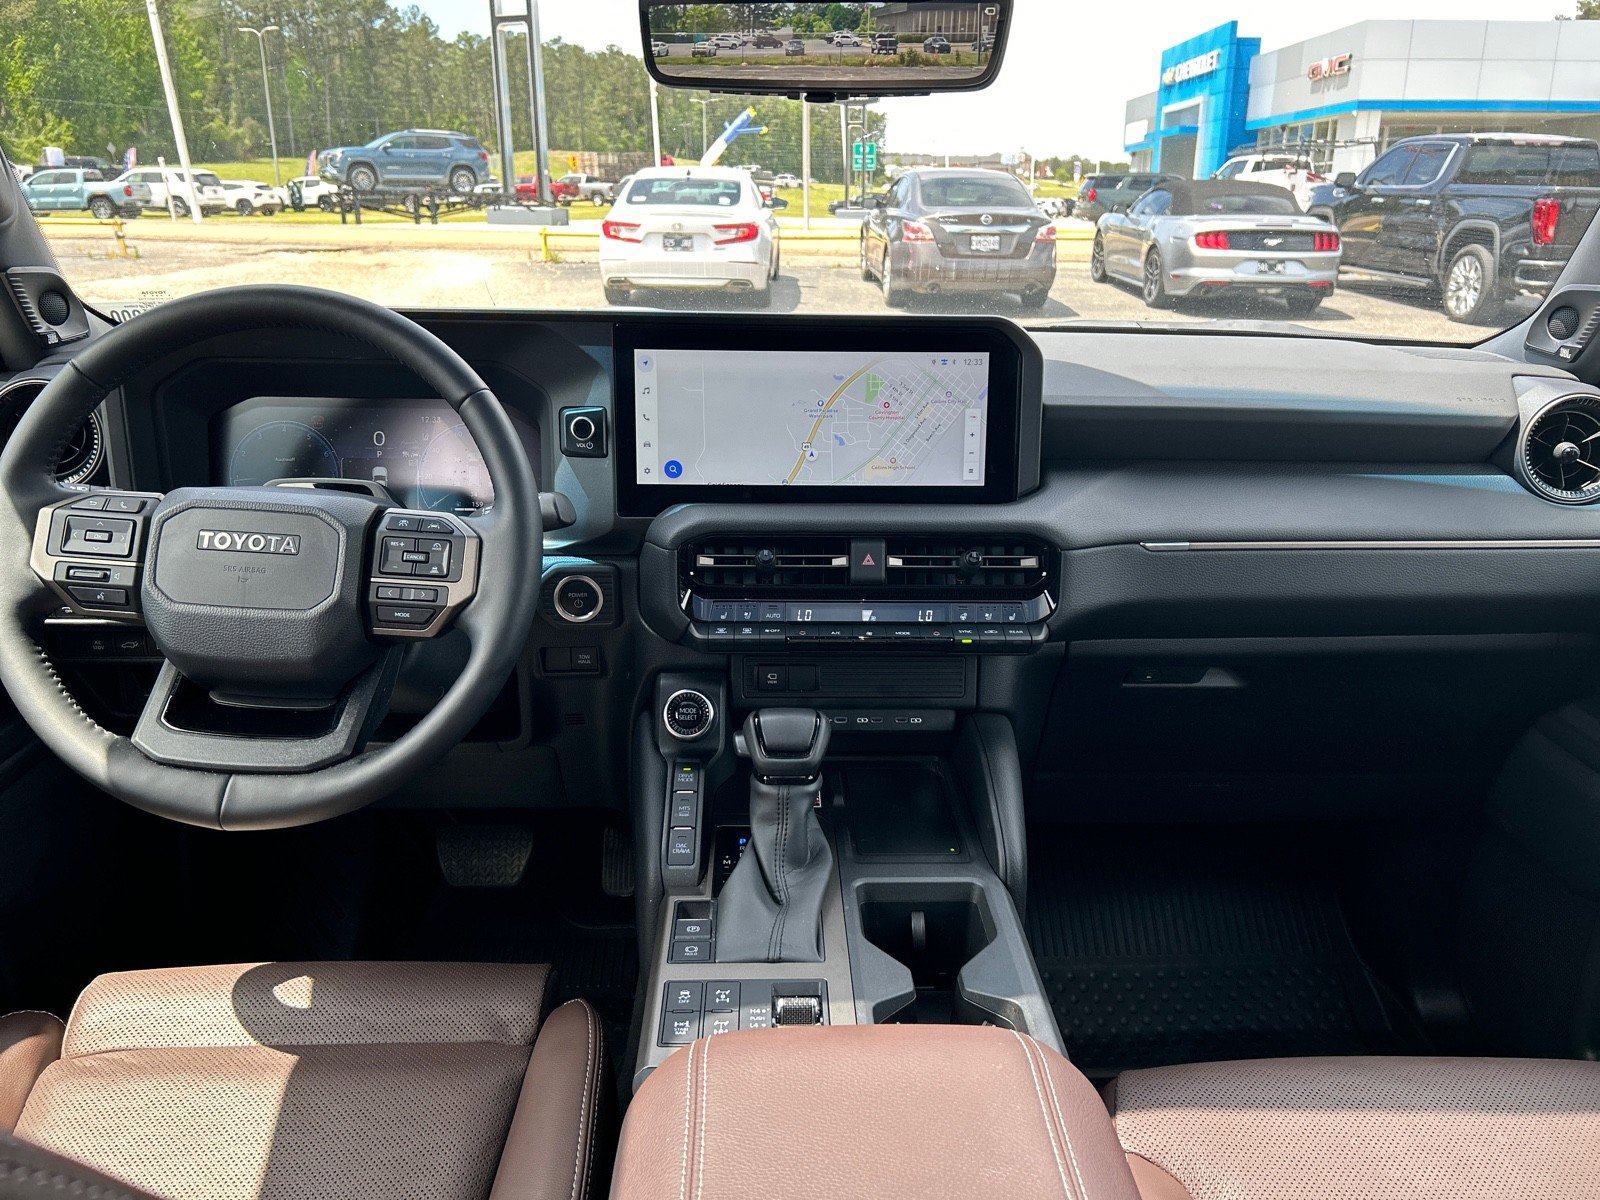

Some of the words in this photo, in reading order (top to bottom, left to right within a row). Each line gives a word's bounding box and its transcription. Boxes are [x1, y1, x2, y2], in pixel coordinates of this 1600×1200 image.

[1308, 53, 1352, 81] GMC
[373, 430, 386, 446] 0
[200, 531, 297, 553] TOYOTA
[239, 566, 266, 574] AIRBAG
